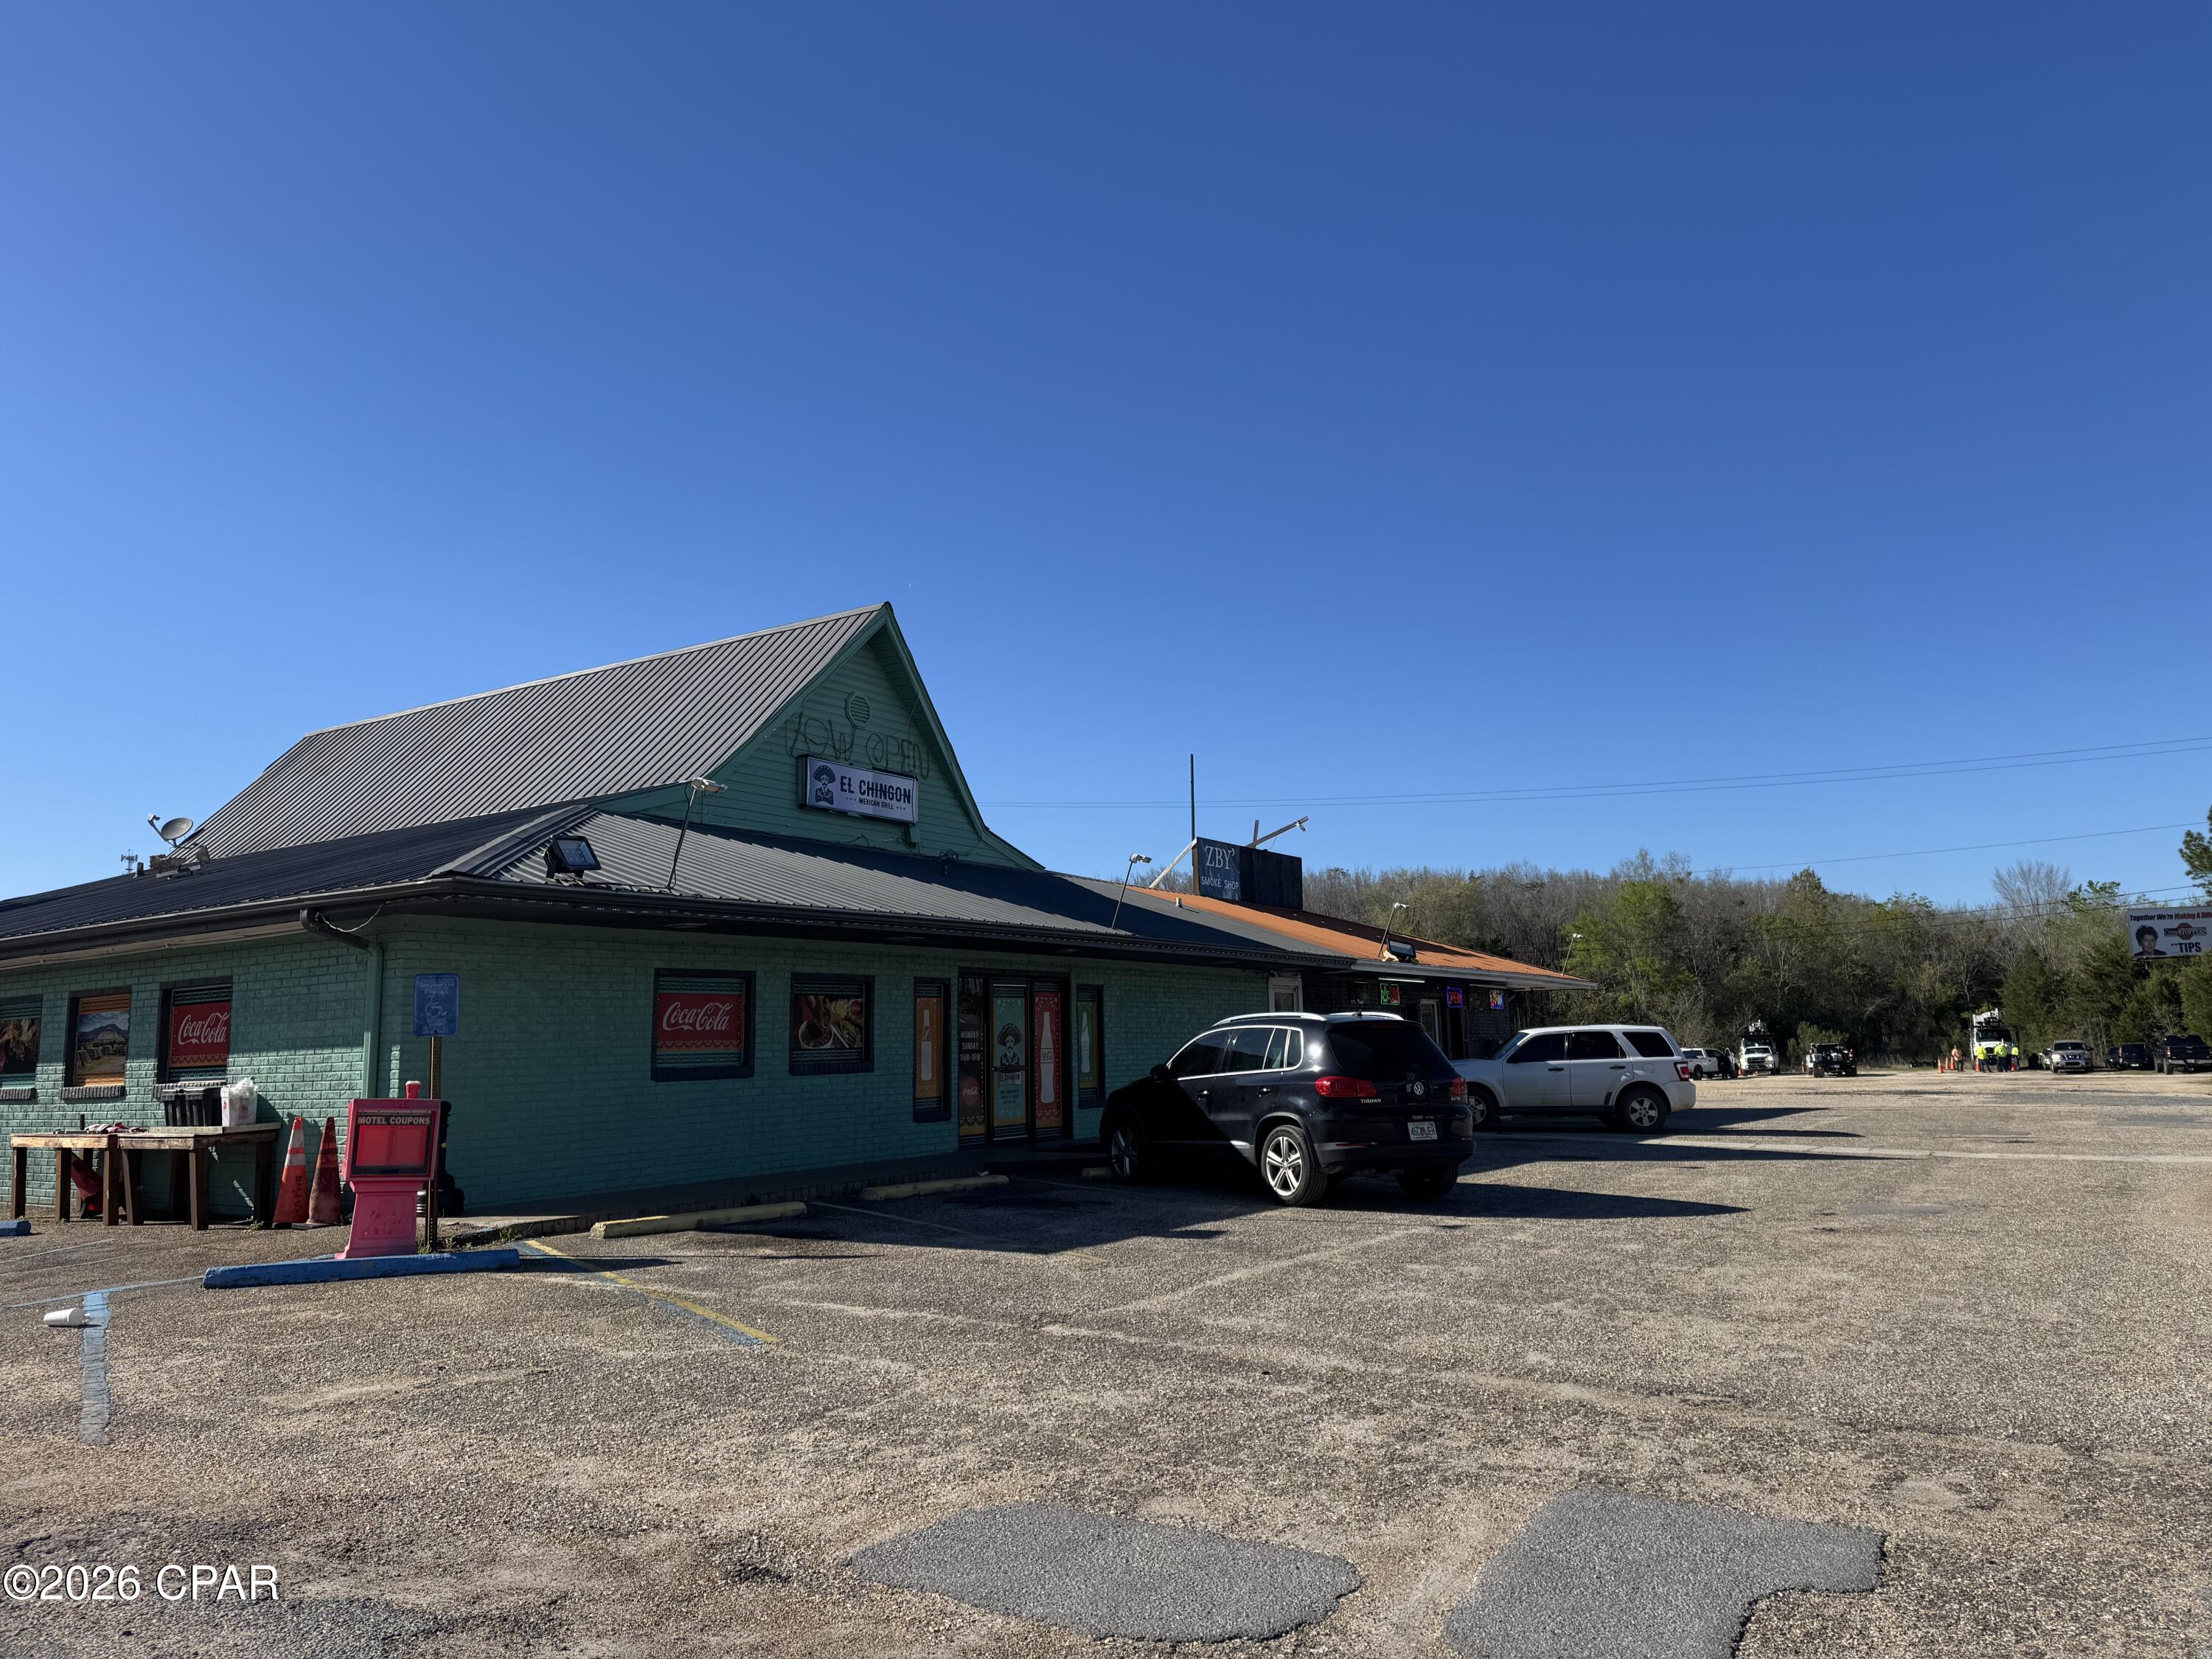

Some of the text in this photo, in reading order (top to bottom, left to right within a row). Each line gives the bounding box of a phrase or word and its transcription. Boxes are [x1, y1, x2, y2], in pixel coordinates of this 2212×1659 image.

[840, 776, 911, 804] EL CHINGON
[859, 797, 894, 810] MEXICAN GRILL
[1201, 876, 1239, 891] SMOKE SHOP
[662, 1001, 734, 1031] Coca-Cola
[178, 1012, 230, 1046] Coca-Cola
[961, 1042, 978, 1050] SUNDAY
[358, 1116, 431, 1125] MOTEL COUPONS
